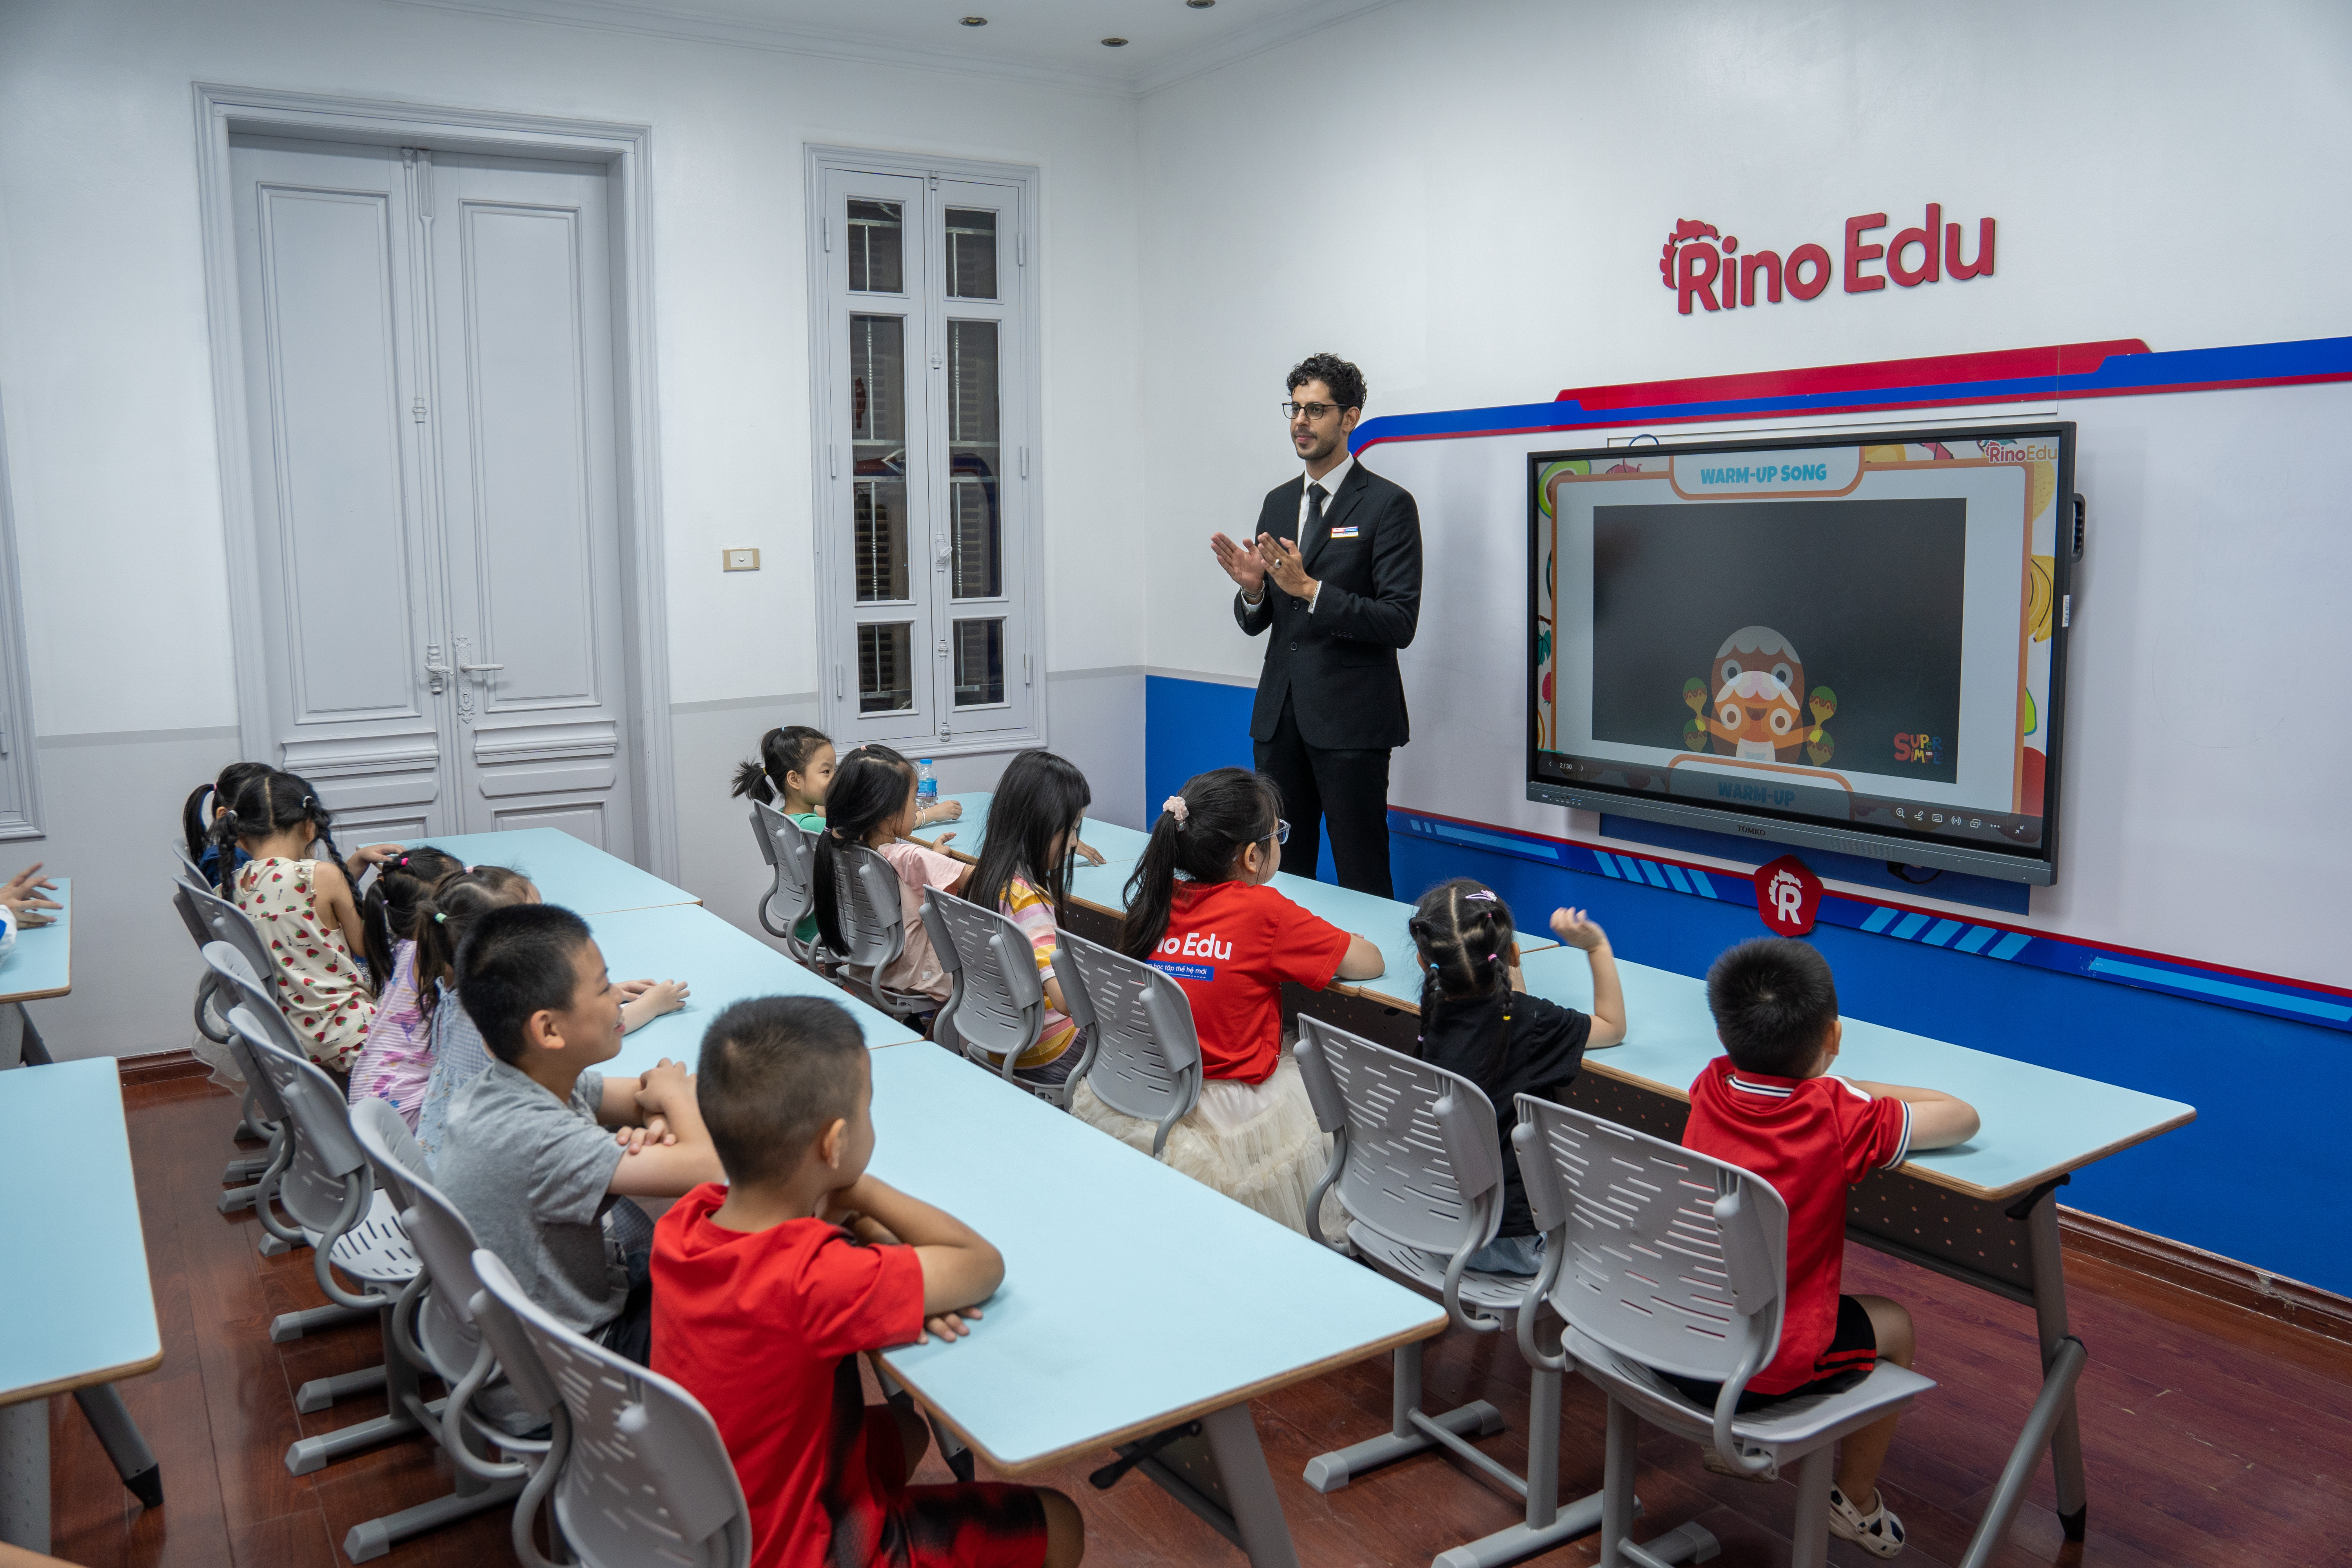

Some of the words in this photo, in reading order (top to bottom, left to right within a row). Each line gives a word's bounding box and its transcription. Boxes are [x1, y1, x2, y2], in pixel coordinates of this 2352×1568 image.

[1677, 235, 1831, 314] Rino
[1844, 203, 1995, 294] Edu
[1700, 466, 1778, 484] WARM-UP
[1781, 463, 1827, 482] SONG
[1718, 781, 1795, 806] WARM-UP
[1737, 825, 1766, 836] TOMKO
[1778, 884, 1802, 924] R
[1182, 933, 1232, 960] Edu
